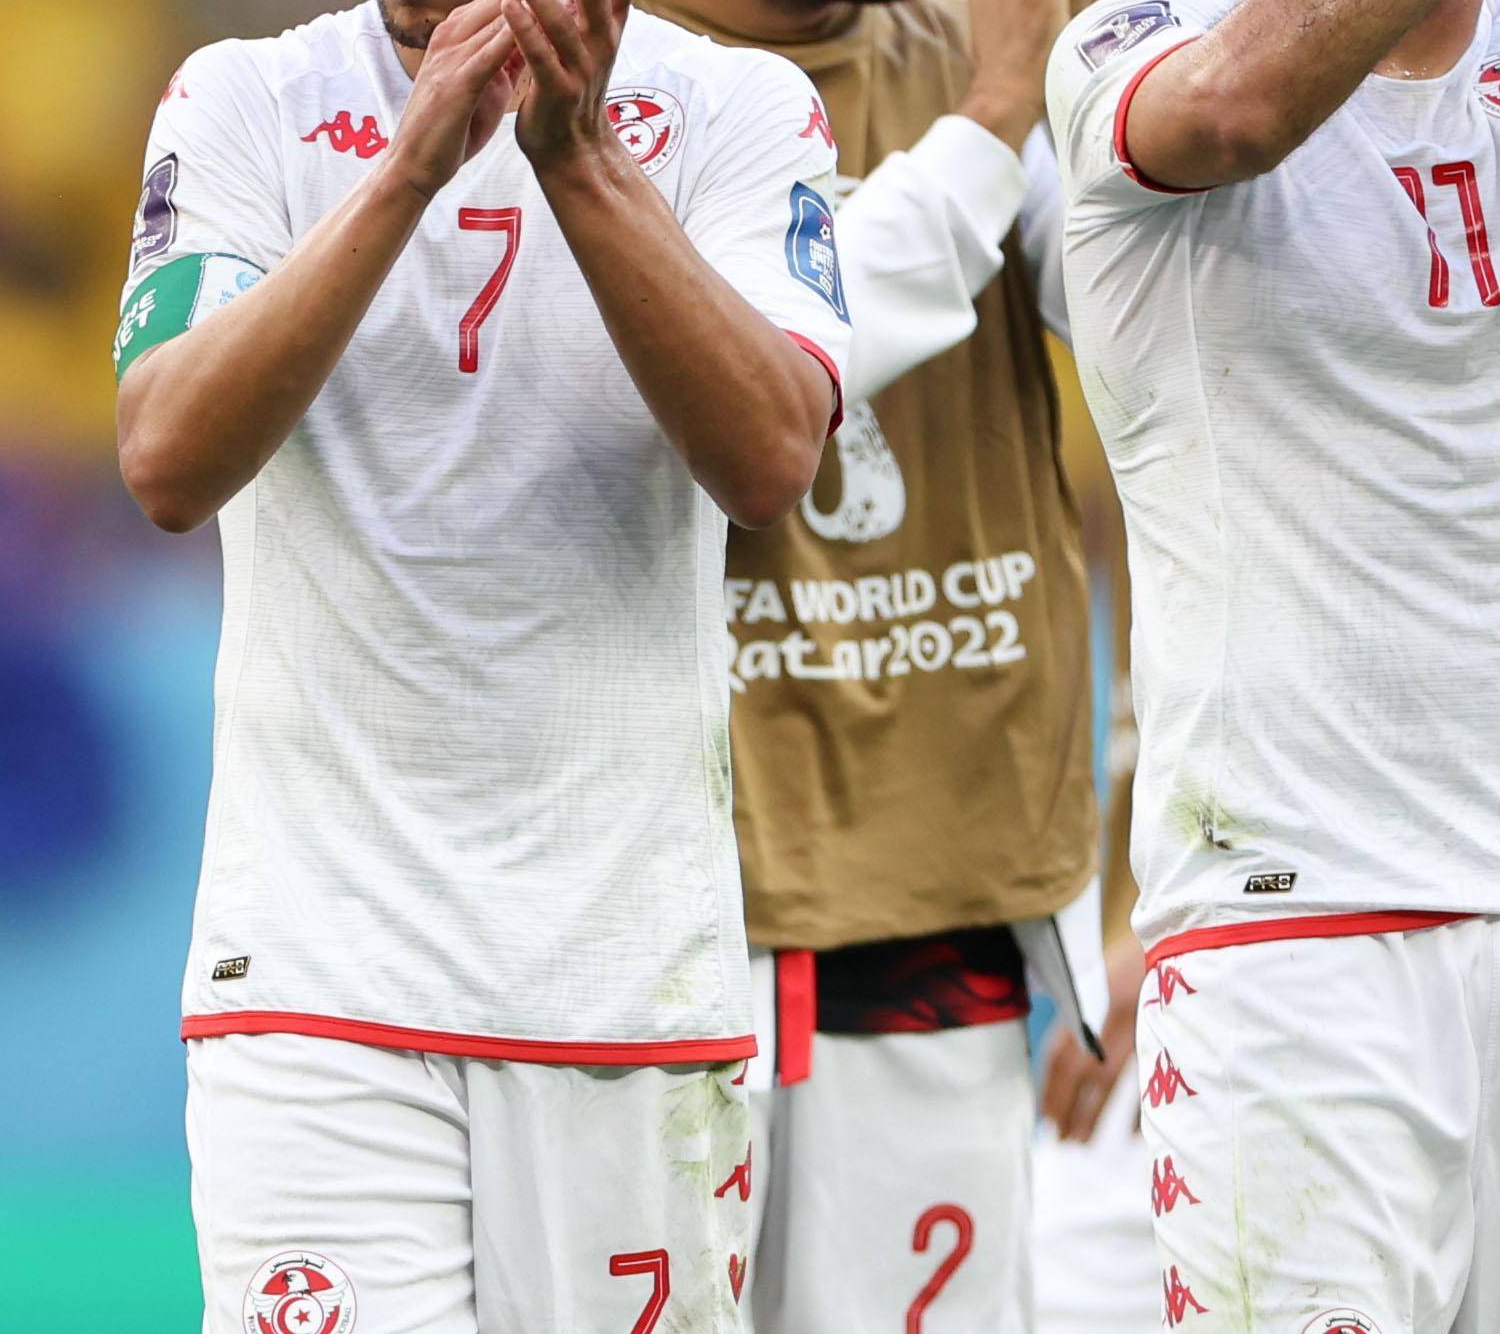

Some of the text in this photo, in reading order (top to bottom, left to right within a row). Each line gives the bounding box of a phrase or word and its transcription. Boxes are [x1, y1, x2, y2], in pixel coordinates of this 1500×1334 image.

[458, 206, 522, 373] 7
[725, 550, 1037, 625] FA WORLD CUP
